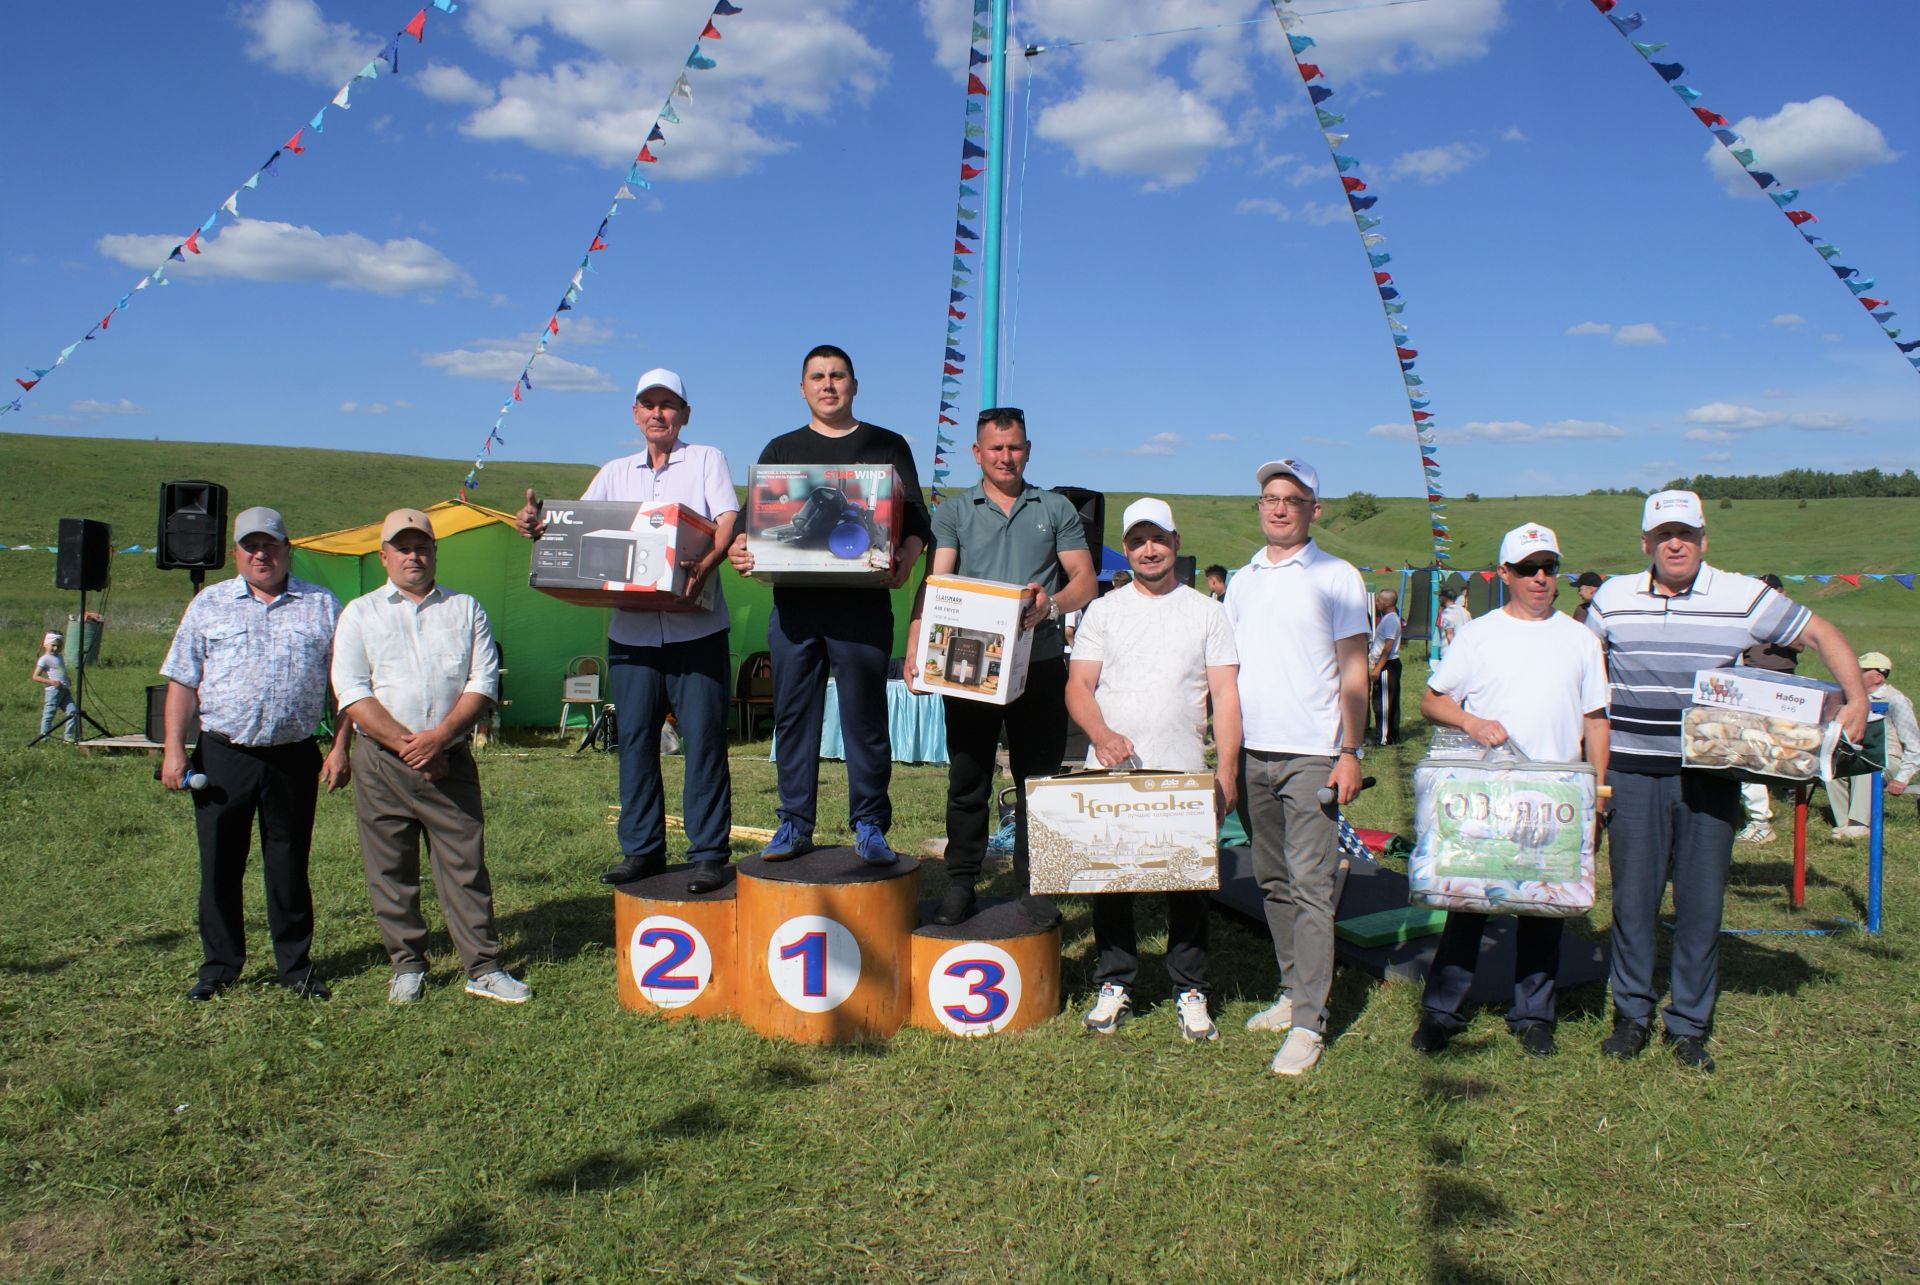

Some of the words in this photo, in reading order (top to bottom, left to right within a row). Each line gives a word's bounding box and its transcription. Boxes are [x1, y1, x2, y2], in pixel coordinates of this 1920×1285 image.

[824, 470, 886, 480] STARWIND
[542, 510, 575, 525] JVC
[1775, 692, 1806, 706] Набор
[1444, 792, 1575, 824] ОДЯЛО
[639, 927, 700, 991] 2
[780, 931, 828, 998] 1
[942, 958, 1010, 1024] 3
